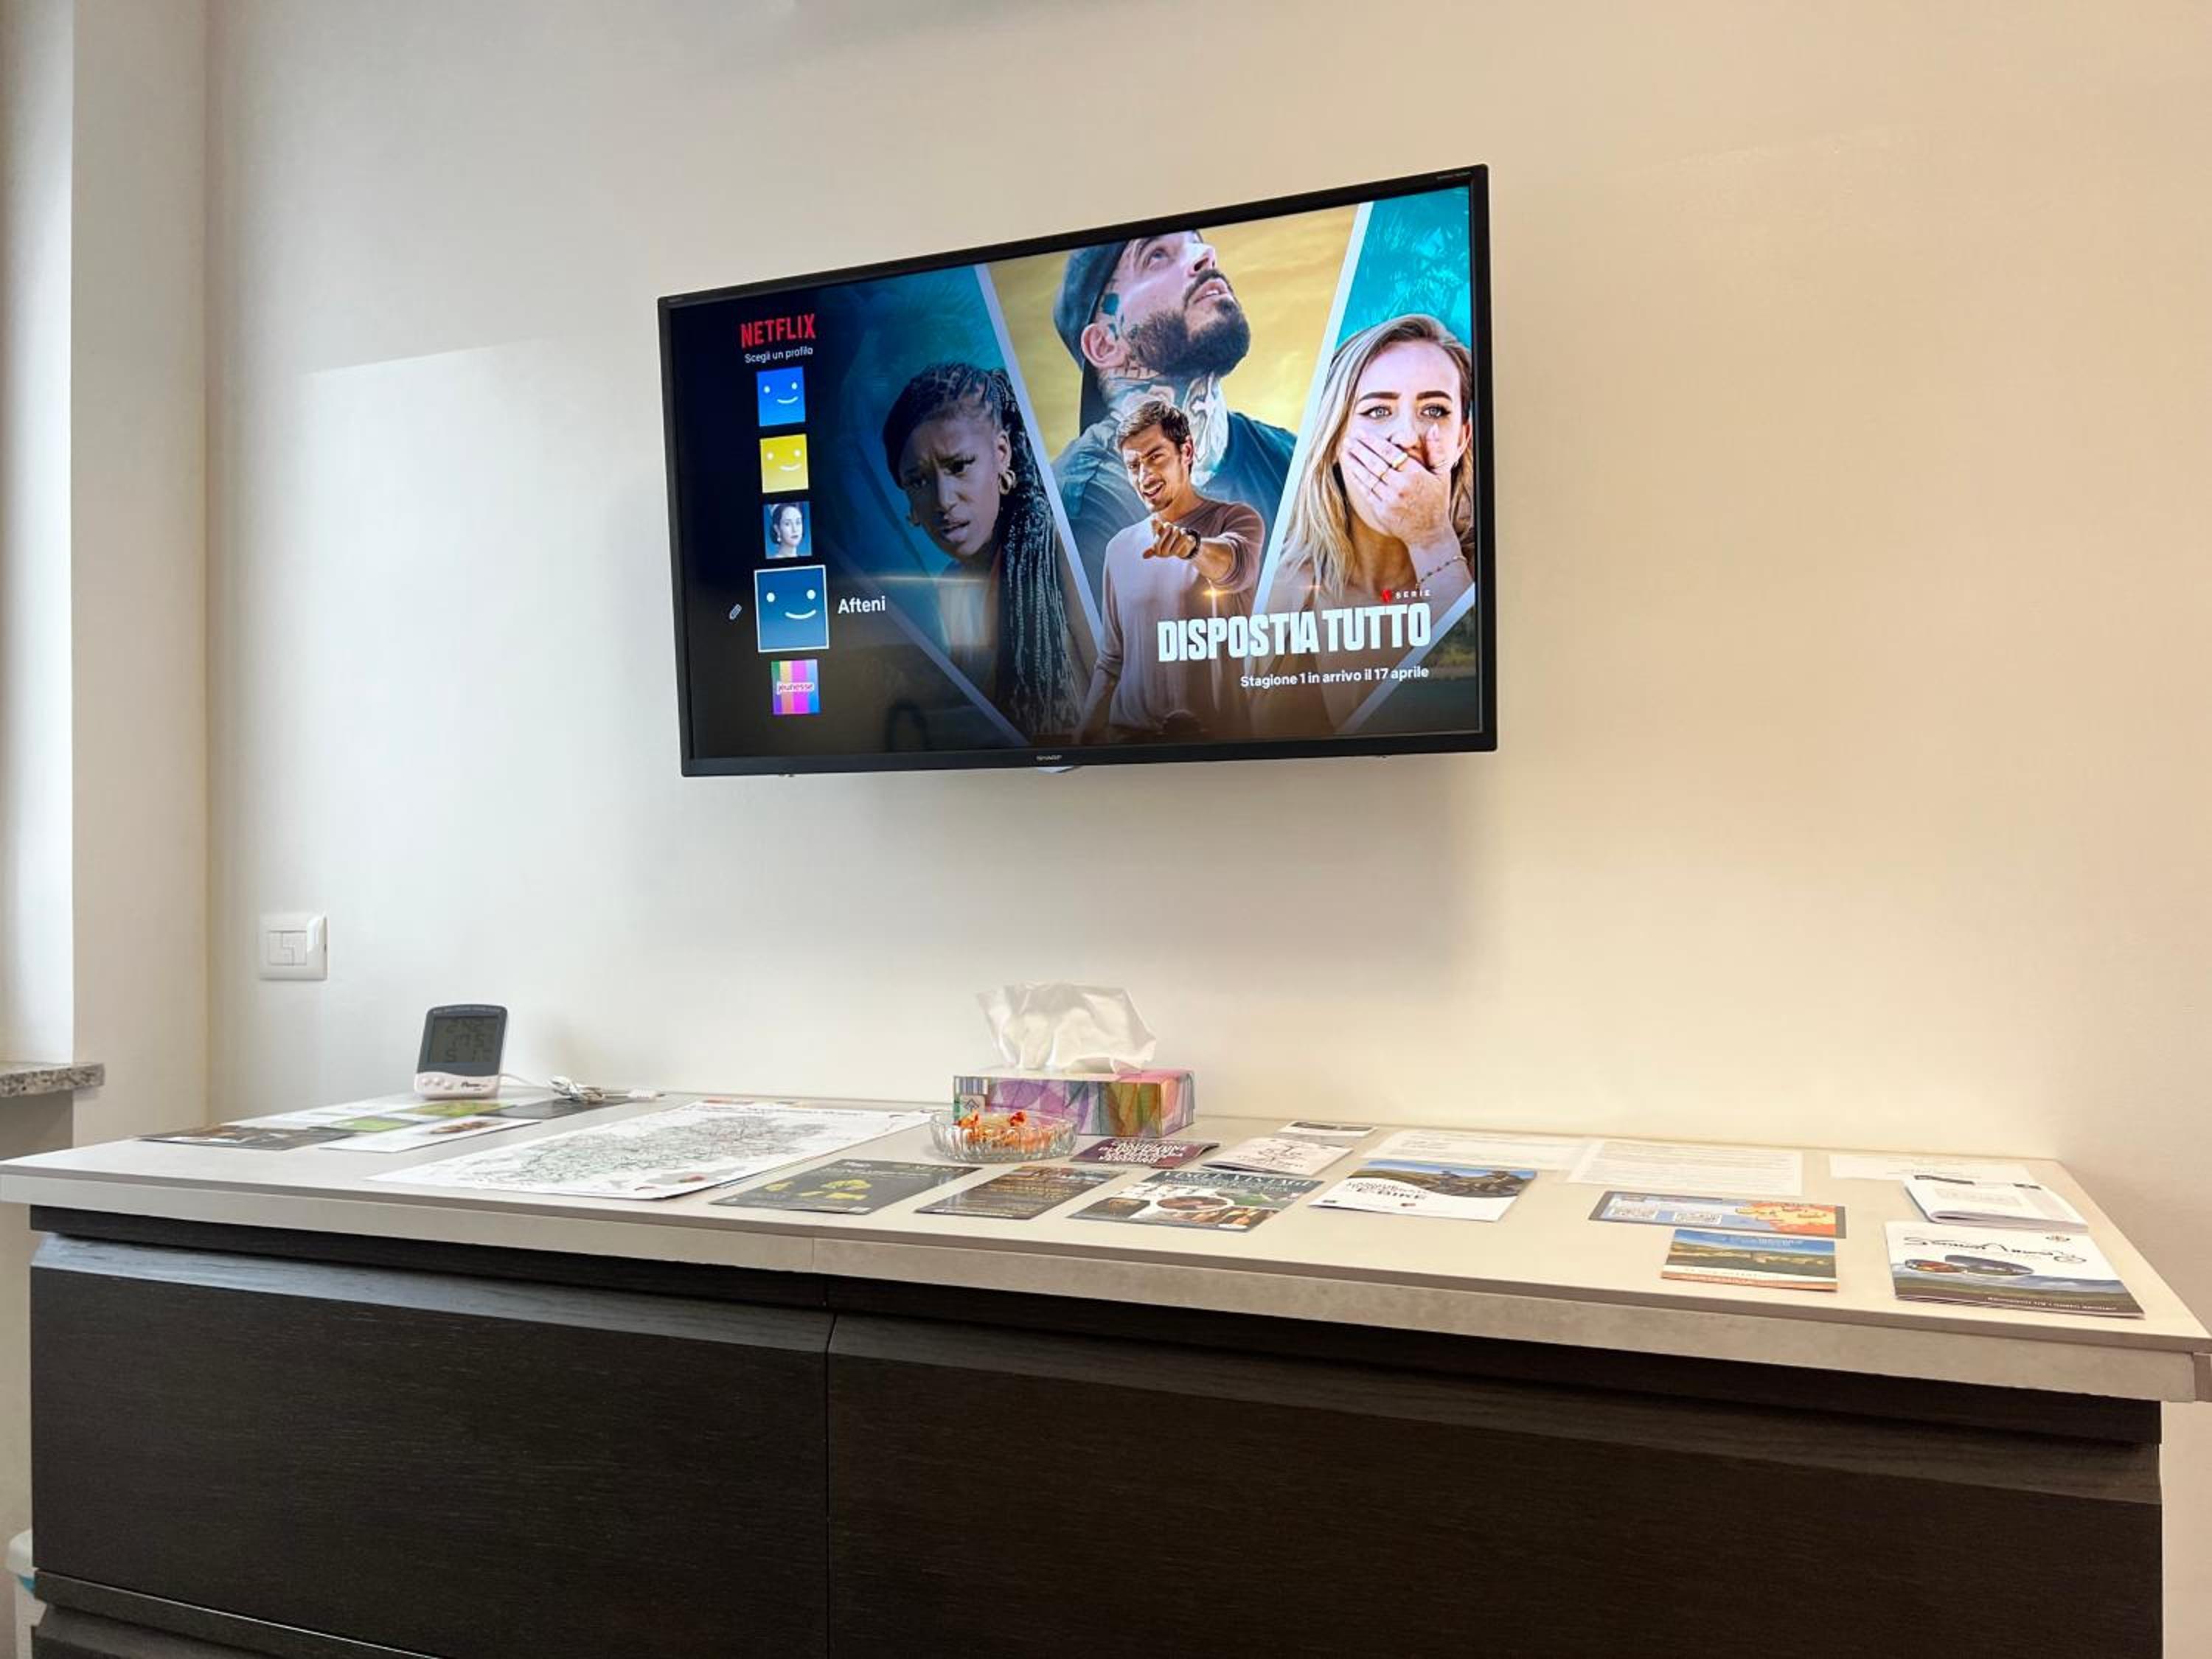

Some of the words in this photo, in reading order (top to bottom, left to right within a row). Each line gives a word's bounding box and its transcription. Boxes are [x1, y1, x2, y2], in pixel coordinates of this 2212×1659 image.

[740, 313, 816, 349] NETFLIX
[744, 349, 771, 364] Scegli
[772, 350, 785, 361] un
[785, 345, 814, 361] profilo
[837, 595, 886, 614] Afteni
[1394, 589, 1432, 599] SERIE
[1322, 602, 1432, 653] TUTTO
[1239, 673, 1298, 690] Stagione
[1299, 671, 1307, 684] 1
[1307, 671, 1321, 684] in
[1322, 669, 1363, 683] arrivo
[1363, 668, 1373, 681] il
[1374, 667, 1389, 681] 17
[1391, 665, 1430, 681] aprile
